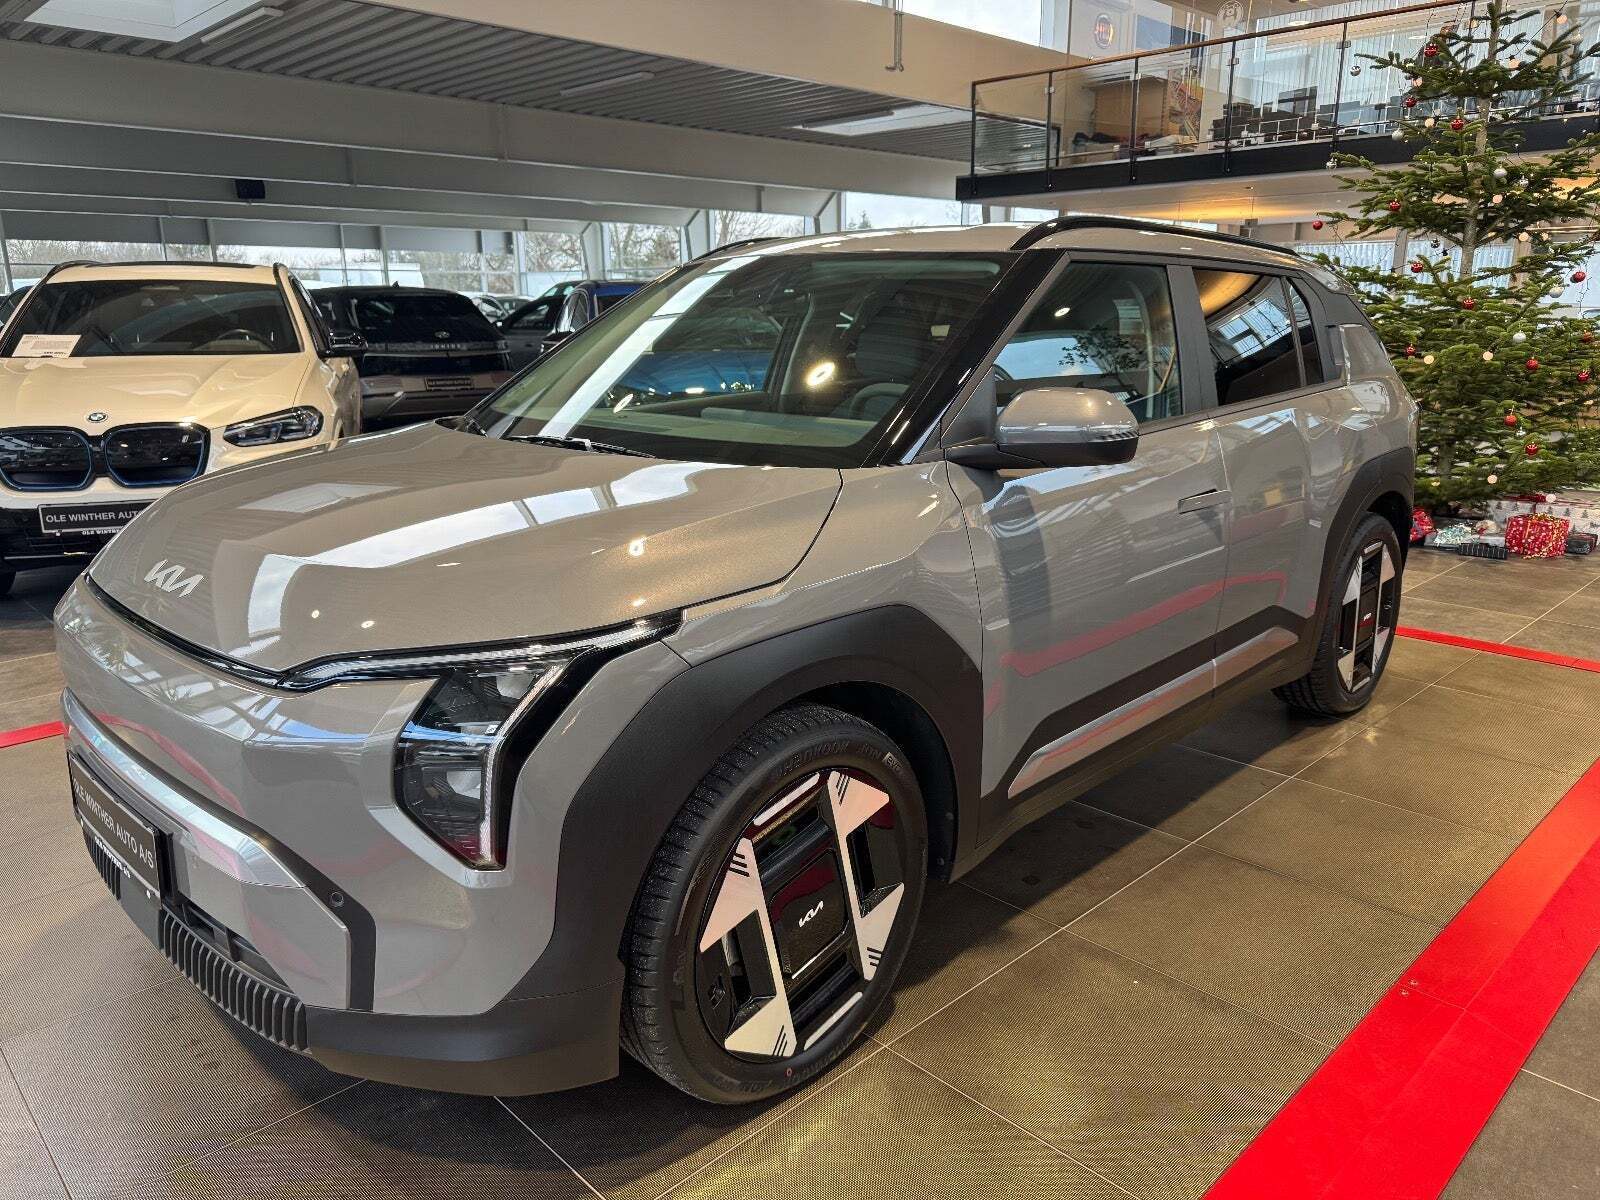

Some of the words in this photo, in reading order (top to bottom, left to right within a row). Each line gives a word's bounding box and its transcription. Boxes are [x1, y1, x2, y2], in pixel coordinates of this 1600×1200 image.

[45, 514, 66, 523] OLE
[68, 511, 116, 522] WINTHER
[118, 510, 141, 520] AUT
[143, 559, 204, 598] KIA
[116, 823, 138, 854] AUTO
[139, 845, 154, 870] A/S
[798, 900, 824, 928] KIA
